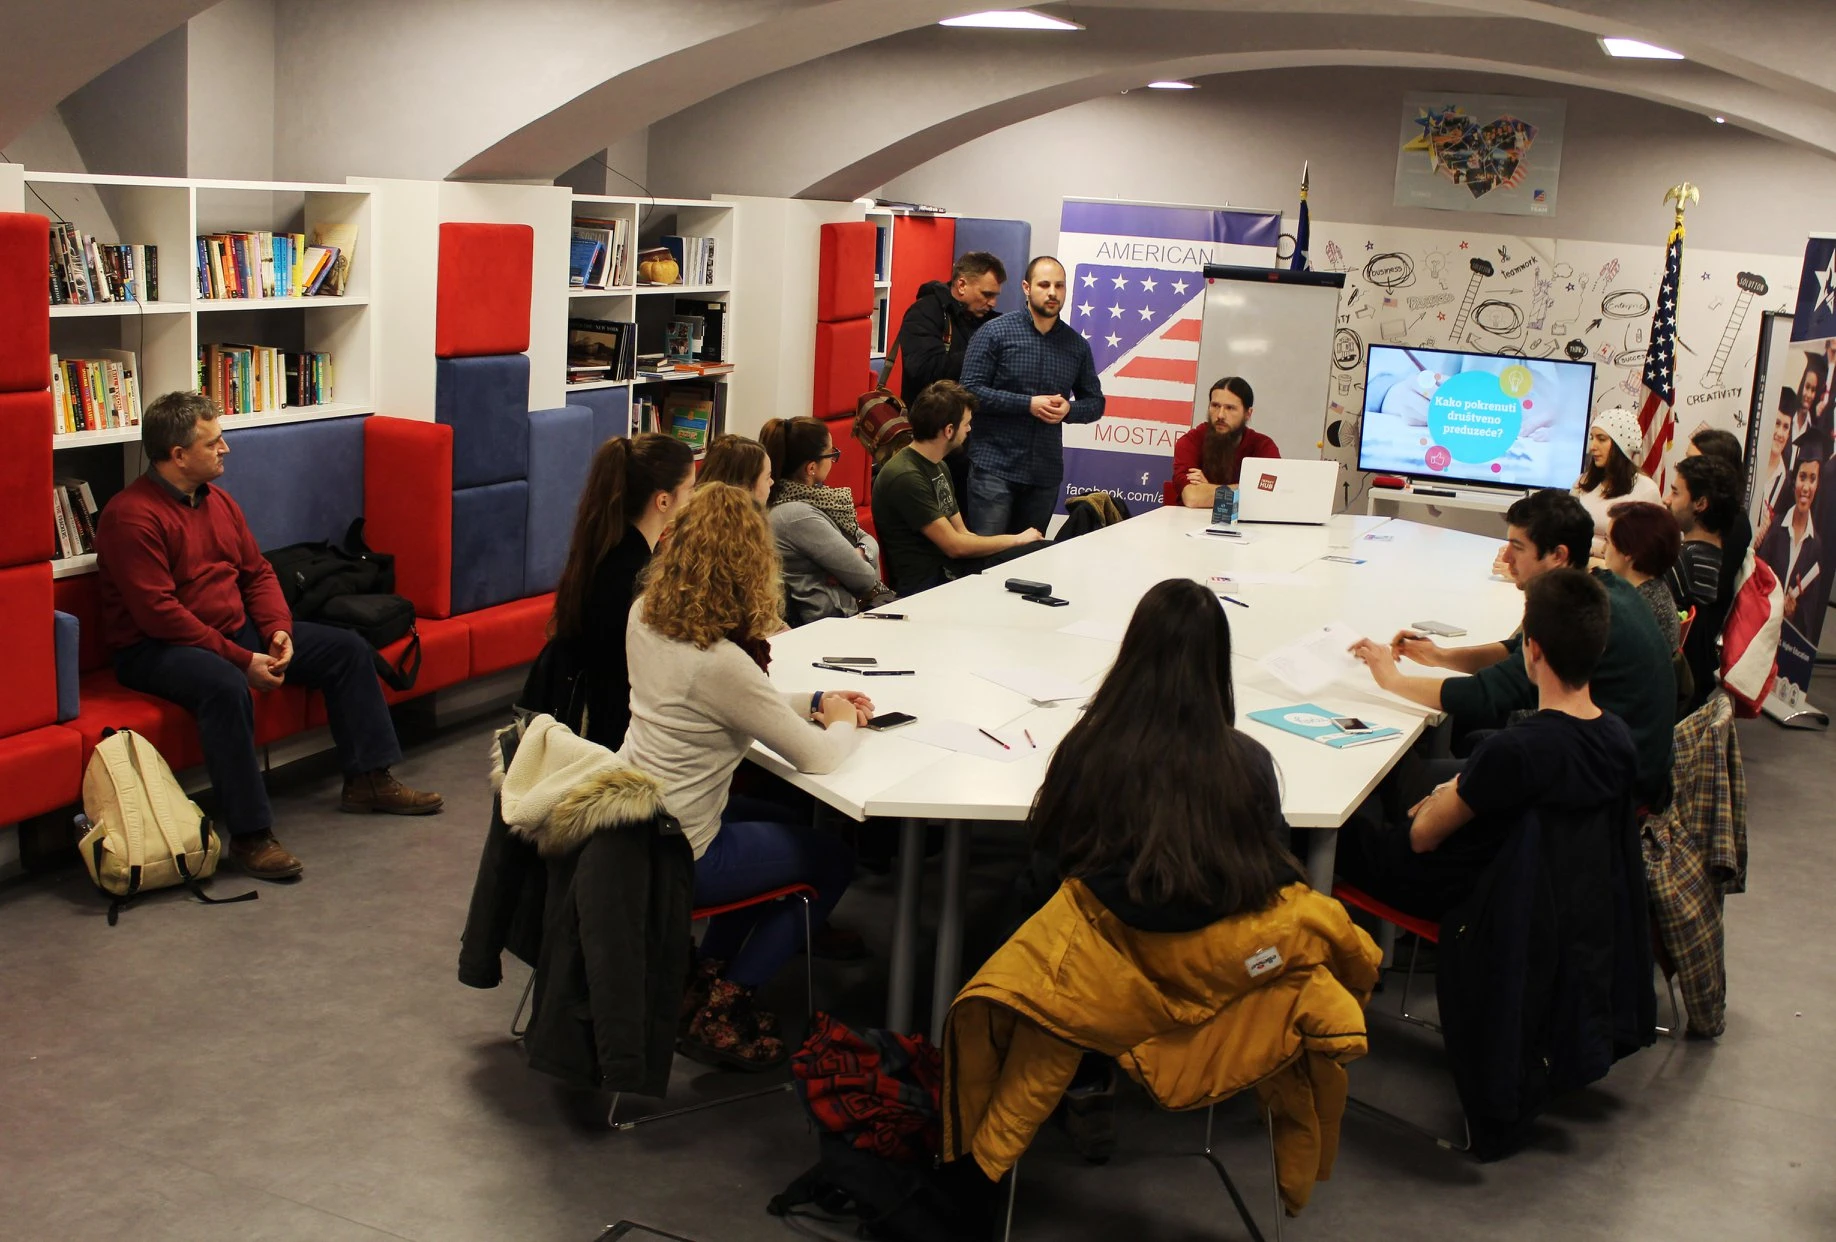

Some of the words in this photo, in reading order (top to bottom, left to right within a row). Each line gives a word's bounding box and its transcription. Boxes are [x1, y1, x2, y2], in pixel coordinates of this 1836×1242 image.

[1096, 241, 1214, 266] AMERICAN
[1738, 277, 1764, 292] SOLUTION
[1621, 354, 1645, 364] succes
[1435, 396, 1462, 408] Kako
[1464, 399, 1517, 413] pokrenuti
[1447, 410, 1501, 425] društveno
[1442, 424, 1504, 438] preduzeće?
[1259, 482, 1273, 490] HUB
